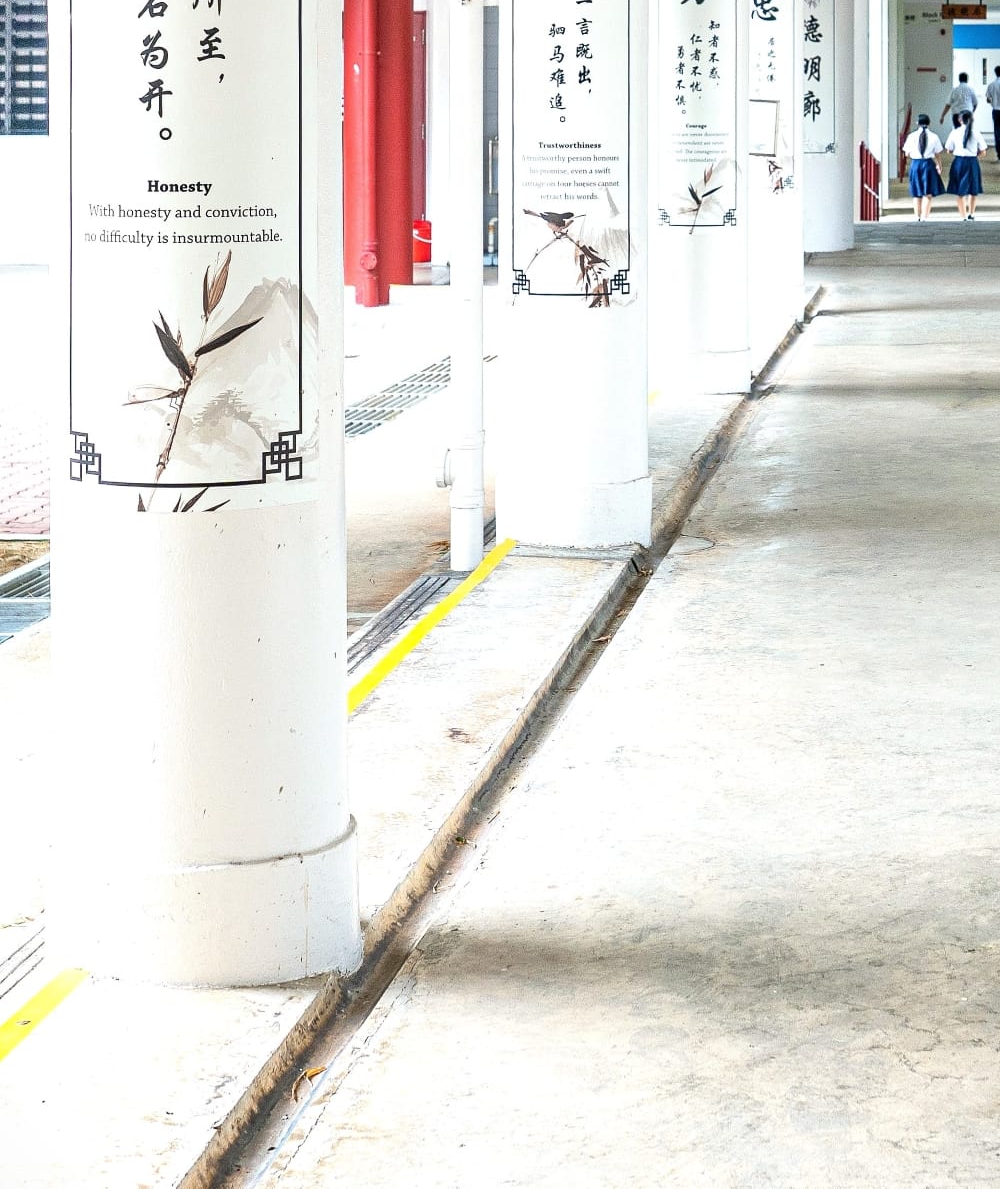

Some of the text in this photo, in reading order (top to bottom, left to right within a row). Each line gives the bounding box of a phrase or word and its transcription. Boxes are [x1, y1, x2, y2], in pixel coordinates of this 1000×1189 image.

[548, 23, 567, 122] 驷马难追。
[539, 141, 601, 149] Trustworthiness
[147, 179, 213, 196] Honesty
[576, 192, 600, 200] words.
[89, 204, 278, 222] With honesty and conviction,
[84, 229, 283, 247] no difficulty is insurmountable.
